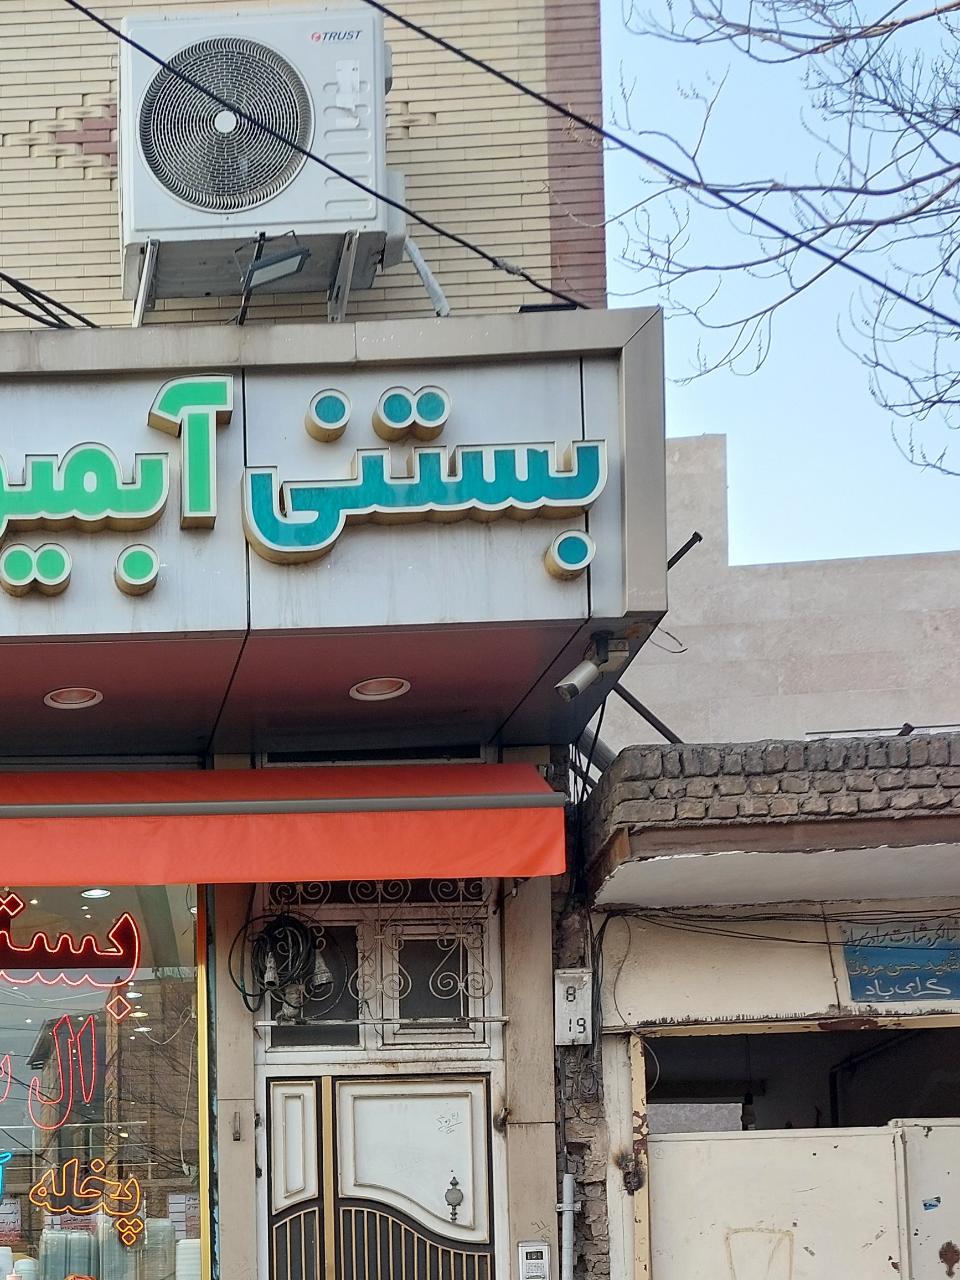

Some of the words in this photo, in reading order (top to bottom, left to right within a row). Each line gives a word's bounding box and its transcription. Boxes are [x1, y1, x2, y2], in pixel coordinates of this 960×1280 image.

[322, 30, 363, 41] TRUST
[243, 385, 608, 580] بستنی
[865, 978, 895, 999] باد
[895, 976, 952, 997] گرامی
[28, 1014, 97, 1130] ال
